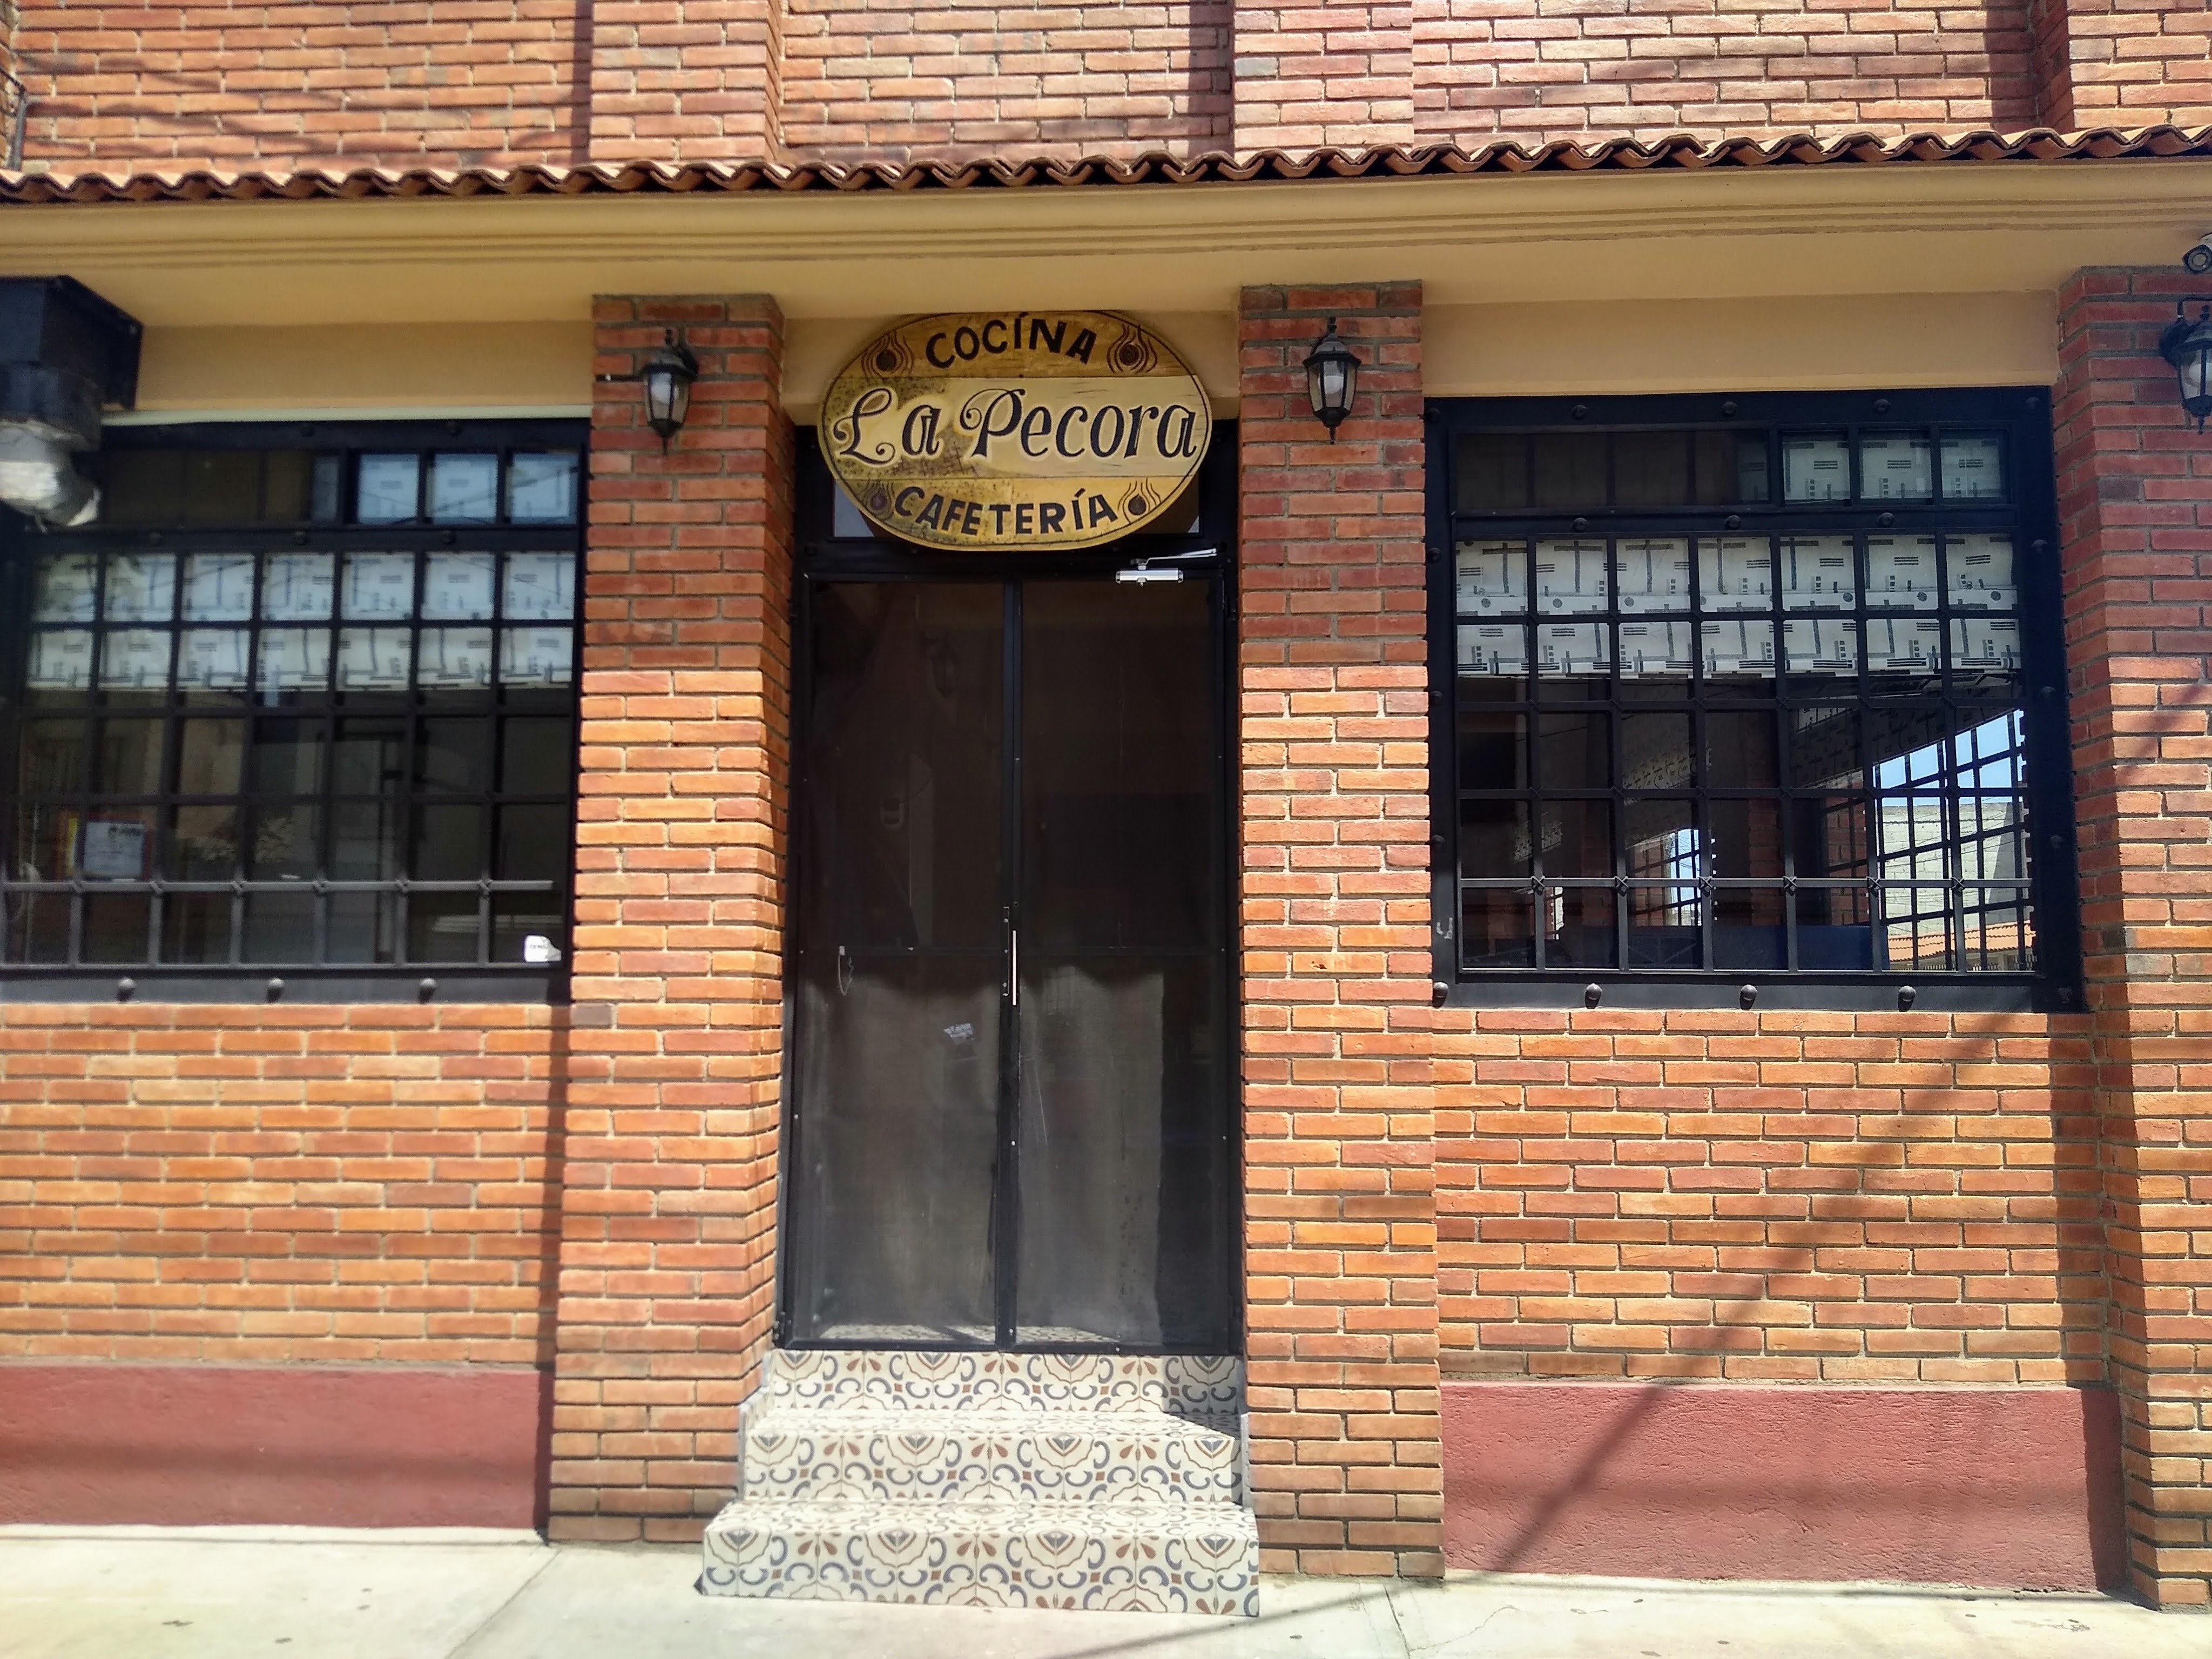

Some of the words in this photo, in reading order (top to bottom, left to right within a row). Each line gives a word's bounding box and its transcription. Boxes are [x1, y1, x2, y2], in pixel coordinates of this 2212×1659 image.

[925, 311, 1097, 369] COCÍNA
[833, 388, 942, 464] La
[959, 388, 1197, 459] Pecora
[894, 487, 1118, 535] CAFETERÍA
